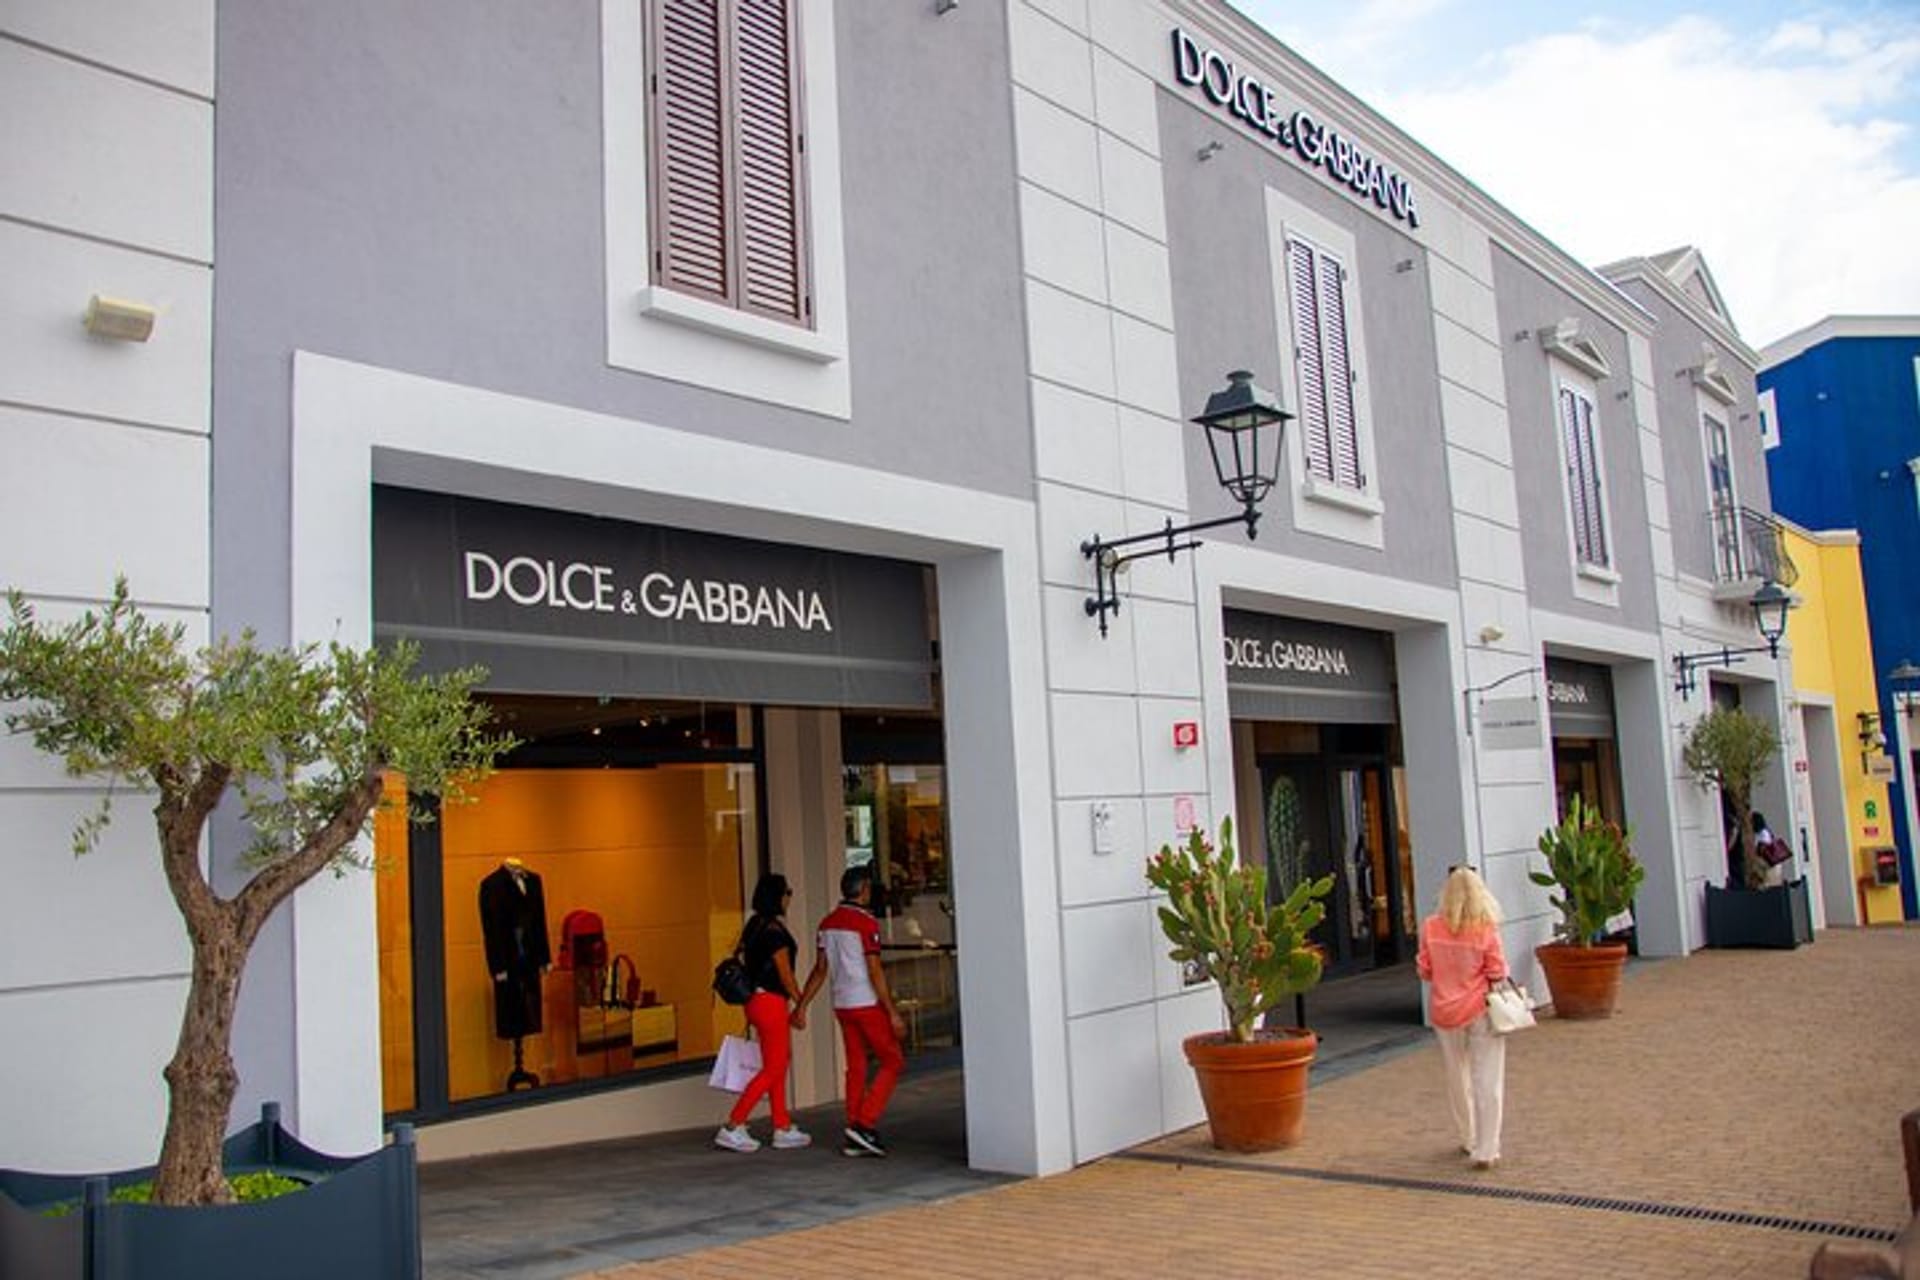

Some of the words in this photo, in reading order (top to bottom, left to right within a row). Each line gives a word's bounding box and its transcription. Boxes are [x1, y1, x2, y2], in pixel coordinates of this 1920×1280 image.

[1171, 28, 1279, 139] DOLCE
[1290, 110, 1419, 228] GABBANA
[465, 551, 614, 612] DOLCE
[621, 589, 637, 615] &
[640, 572, 832, 632] GABBANA
[1223, 636, 1264, 669] OLCE
[1271, 640, 1350, 675] GABBANA
